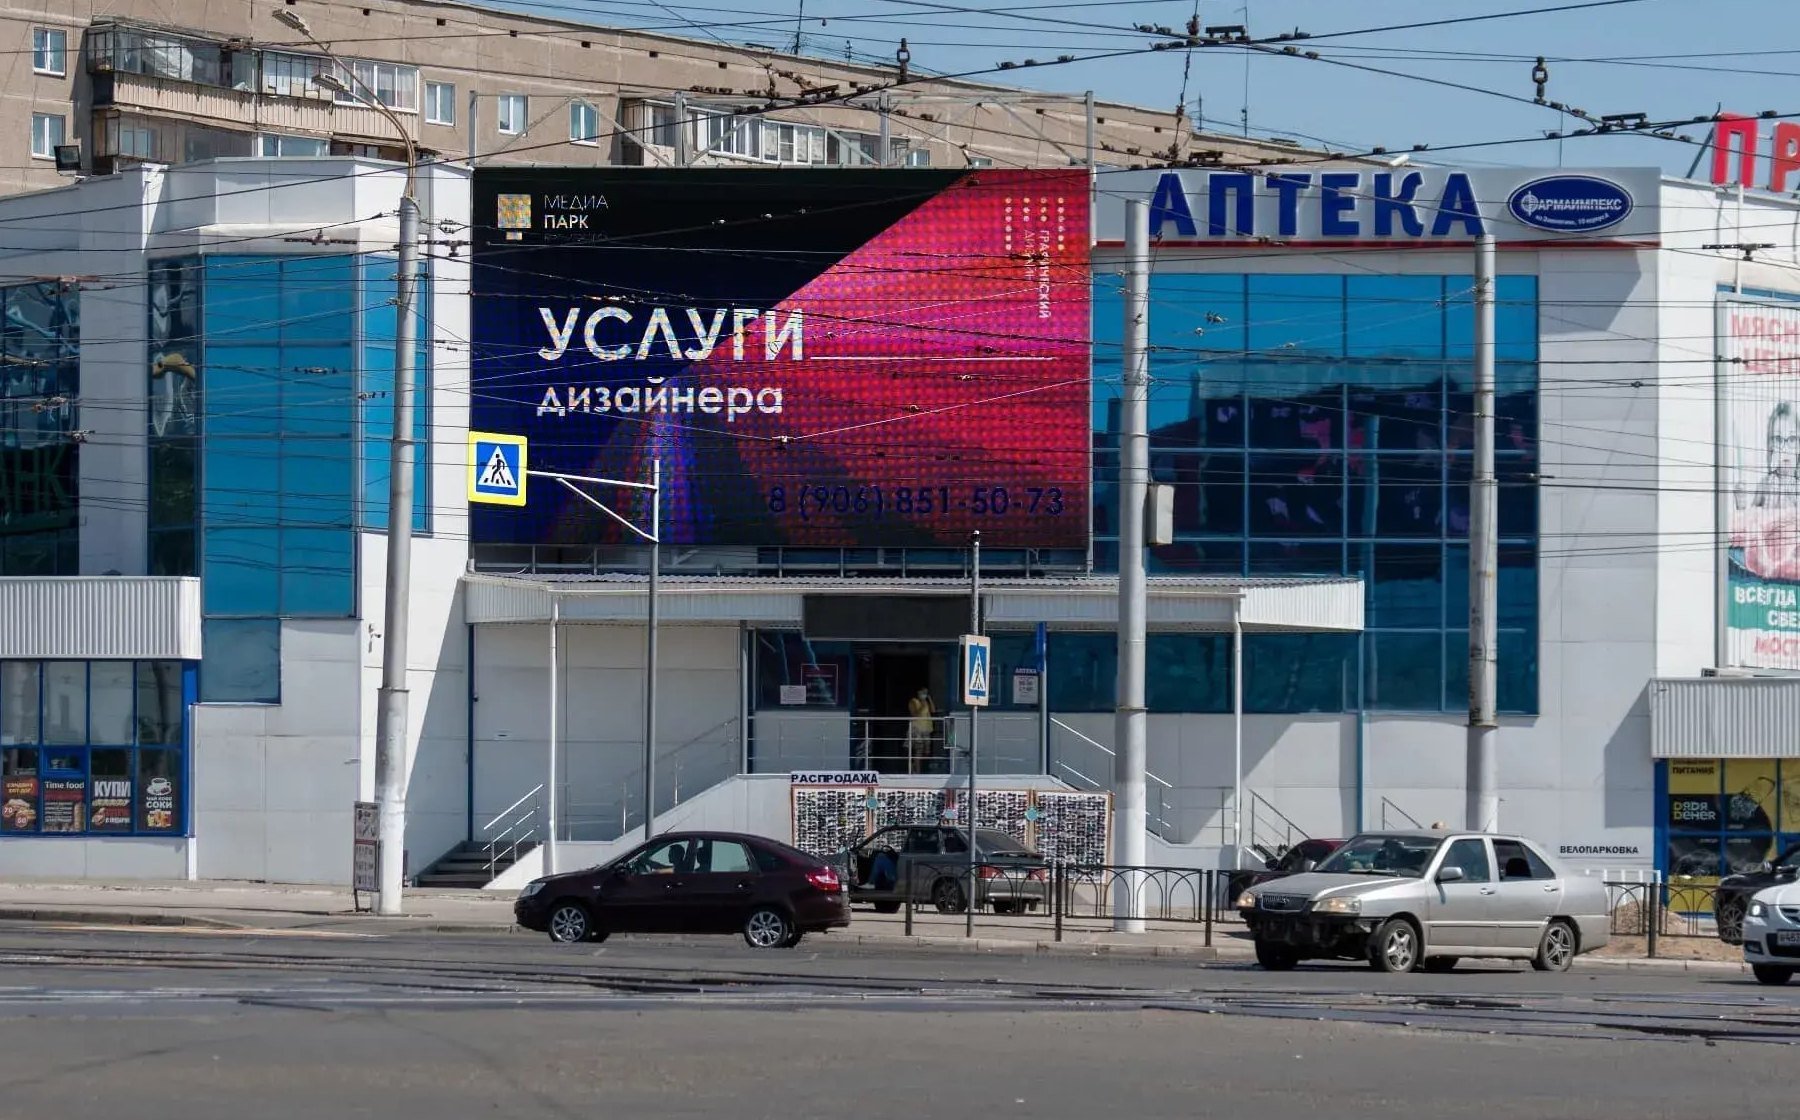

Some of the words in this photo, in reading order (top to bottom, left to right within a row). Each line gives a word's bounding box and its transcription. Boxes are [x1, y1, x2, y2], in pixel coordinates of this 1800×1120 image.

[544, 194, 609, 211] МЕДИА
[1149, 171, 1485, 237] АПТЕКА
[544, 214, 589, 229] ПАРК
[538, 306, 804, 361] УСЛУГИ
[536, 376, 783, 422] дизайнера
[769, 486, 786, 513] 8
[800, 484, 884, 519] (906)
[896, 486, 1064, 515] 851-50-73
[1734, 586, 1797, 607] ВСЕГДА
[44, 781, 65, 789] Time
[66, 781, 85, 789] food
[791, 773, 878, 785] РАСПРОДАЖА
[94, 781, 131, 798] КУПИ
[146, 801, 173, 809] СОКИ
[1560, 845, 1640, 855] ВЕЛОПАРКОВКА
